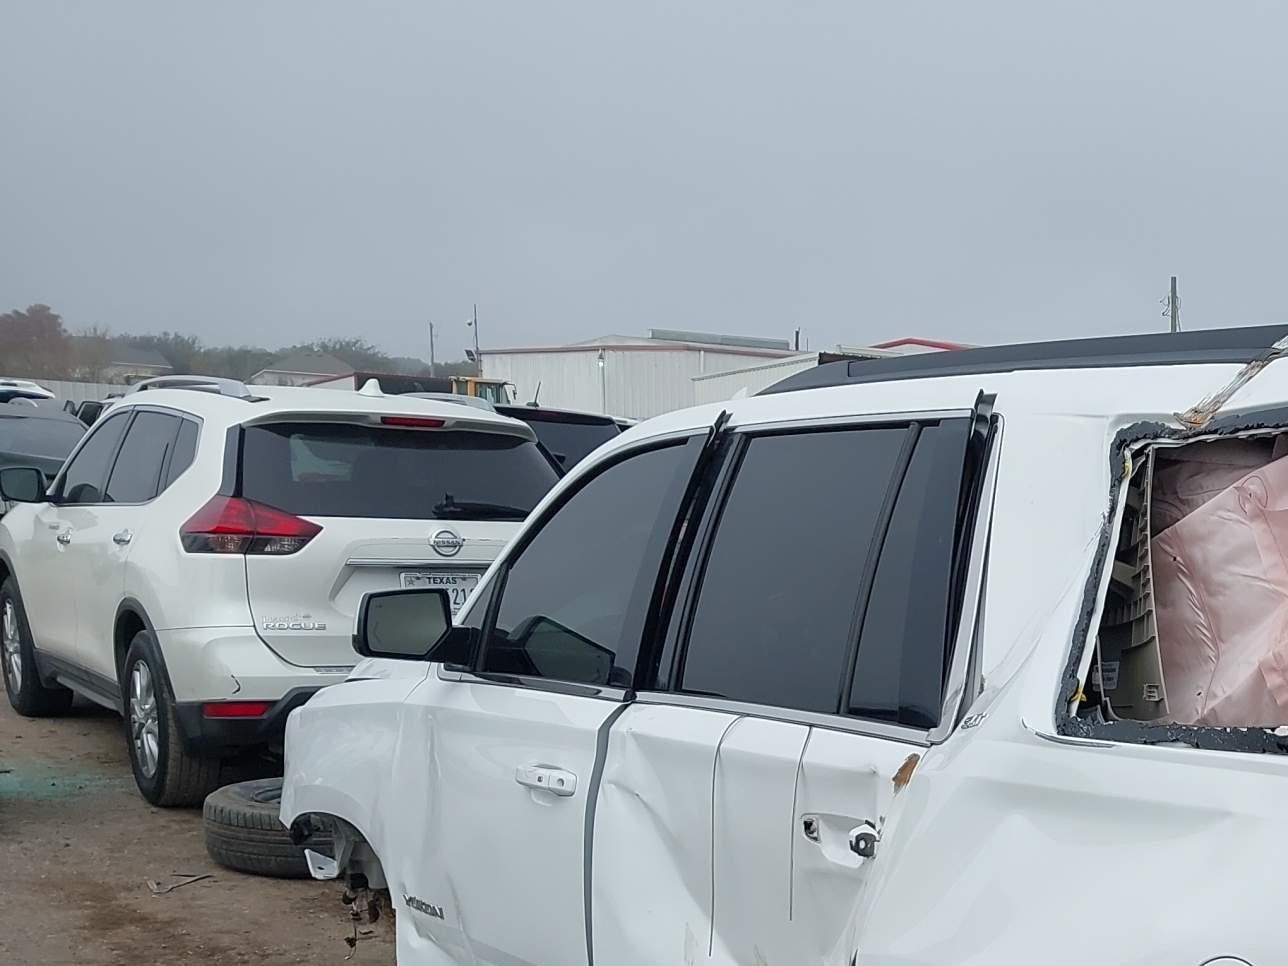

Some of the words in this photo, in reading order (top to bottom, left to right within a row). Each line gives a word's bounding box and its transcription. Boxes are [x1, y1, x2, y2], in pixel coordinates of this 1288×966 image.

[427, 576, 457, 584] TEXAS
[263, 622, 327, 631] ROGUE
[402, 894, 445, 920] YUKON
